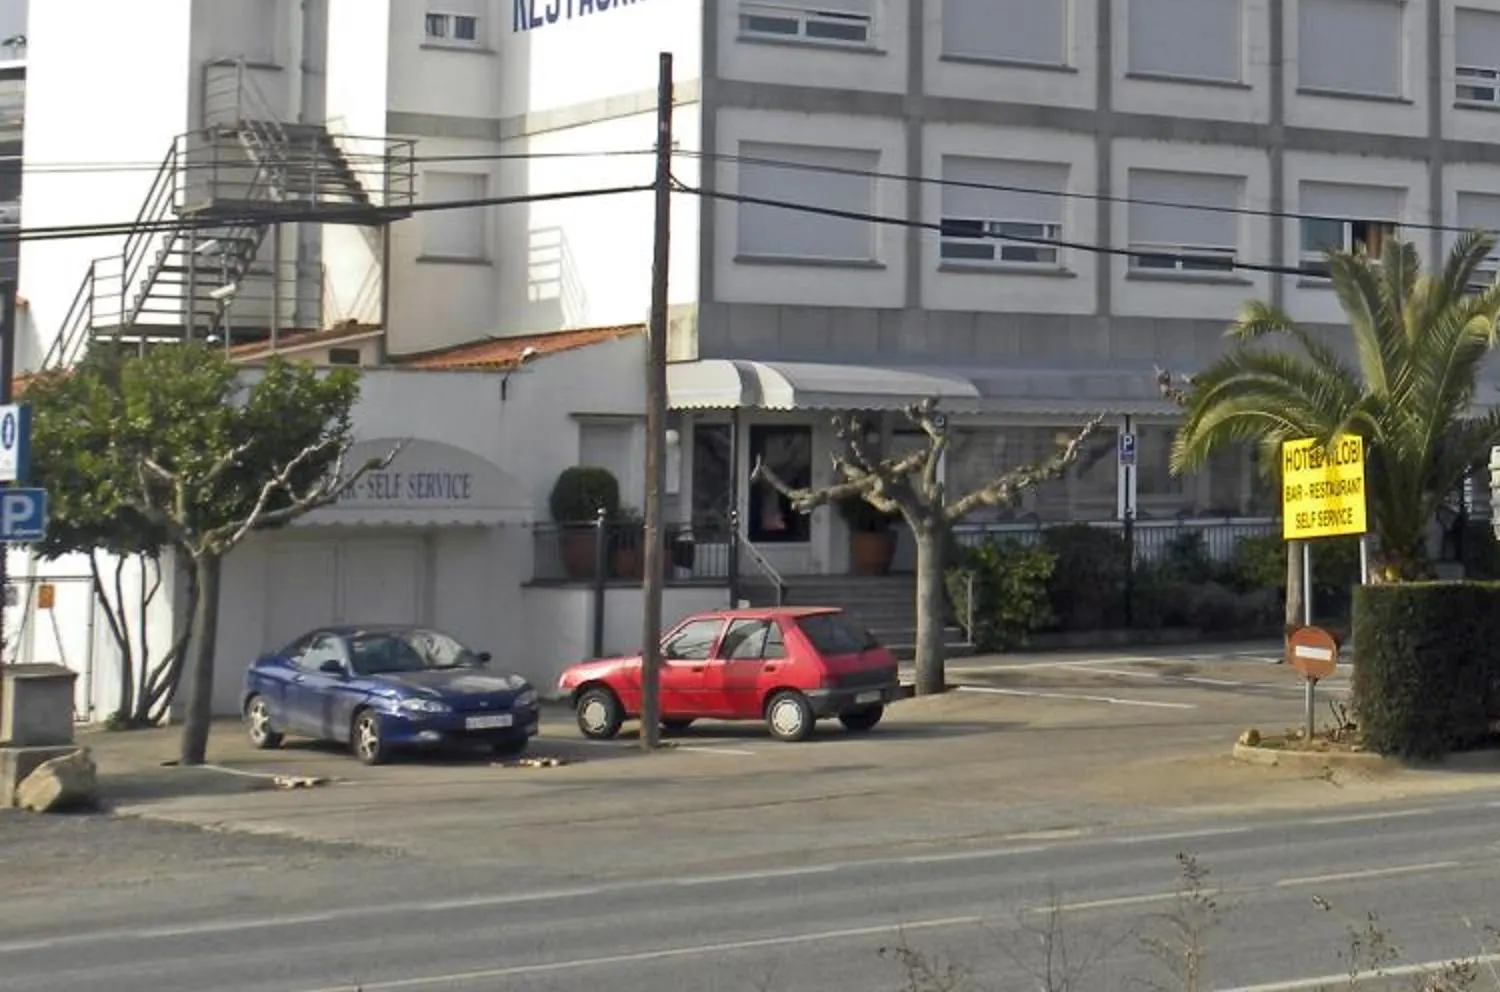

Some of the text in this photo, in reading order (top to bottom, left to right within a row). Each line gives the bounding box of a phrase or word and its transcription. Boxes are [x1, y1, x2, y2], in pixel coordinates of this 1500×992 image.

[407, 472, 473, 500] SERVICE
[2, 495, 35, 535] P
[1296, 511, 1316, 529] SELF
